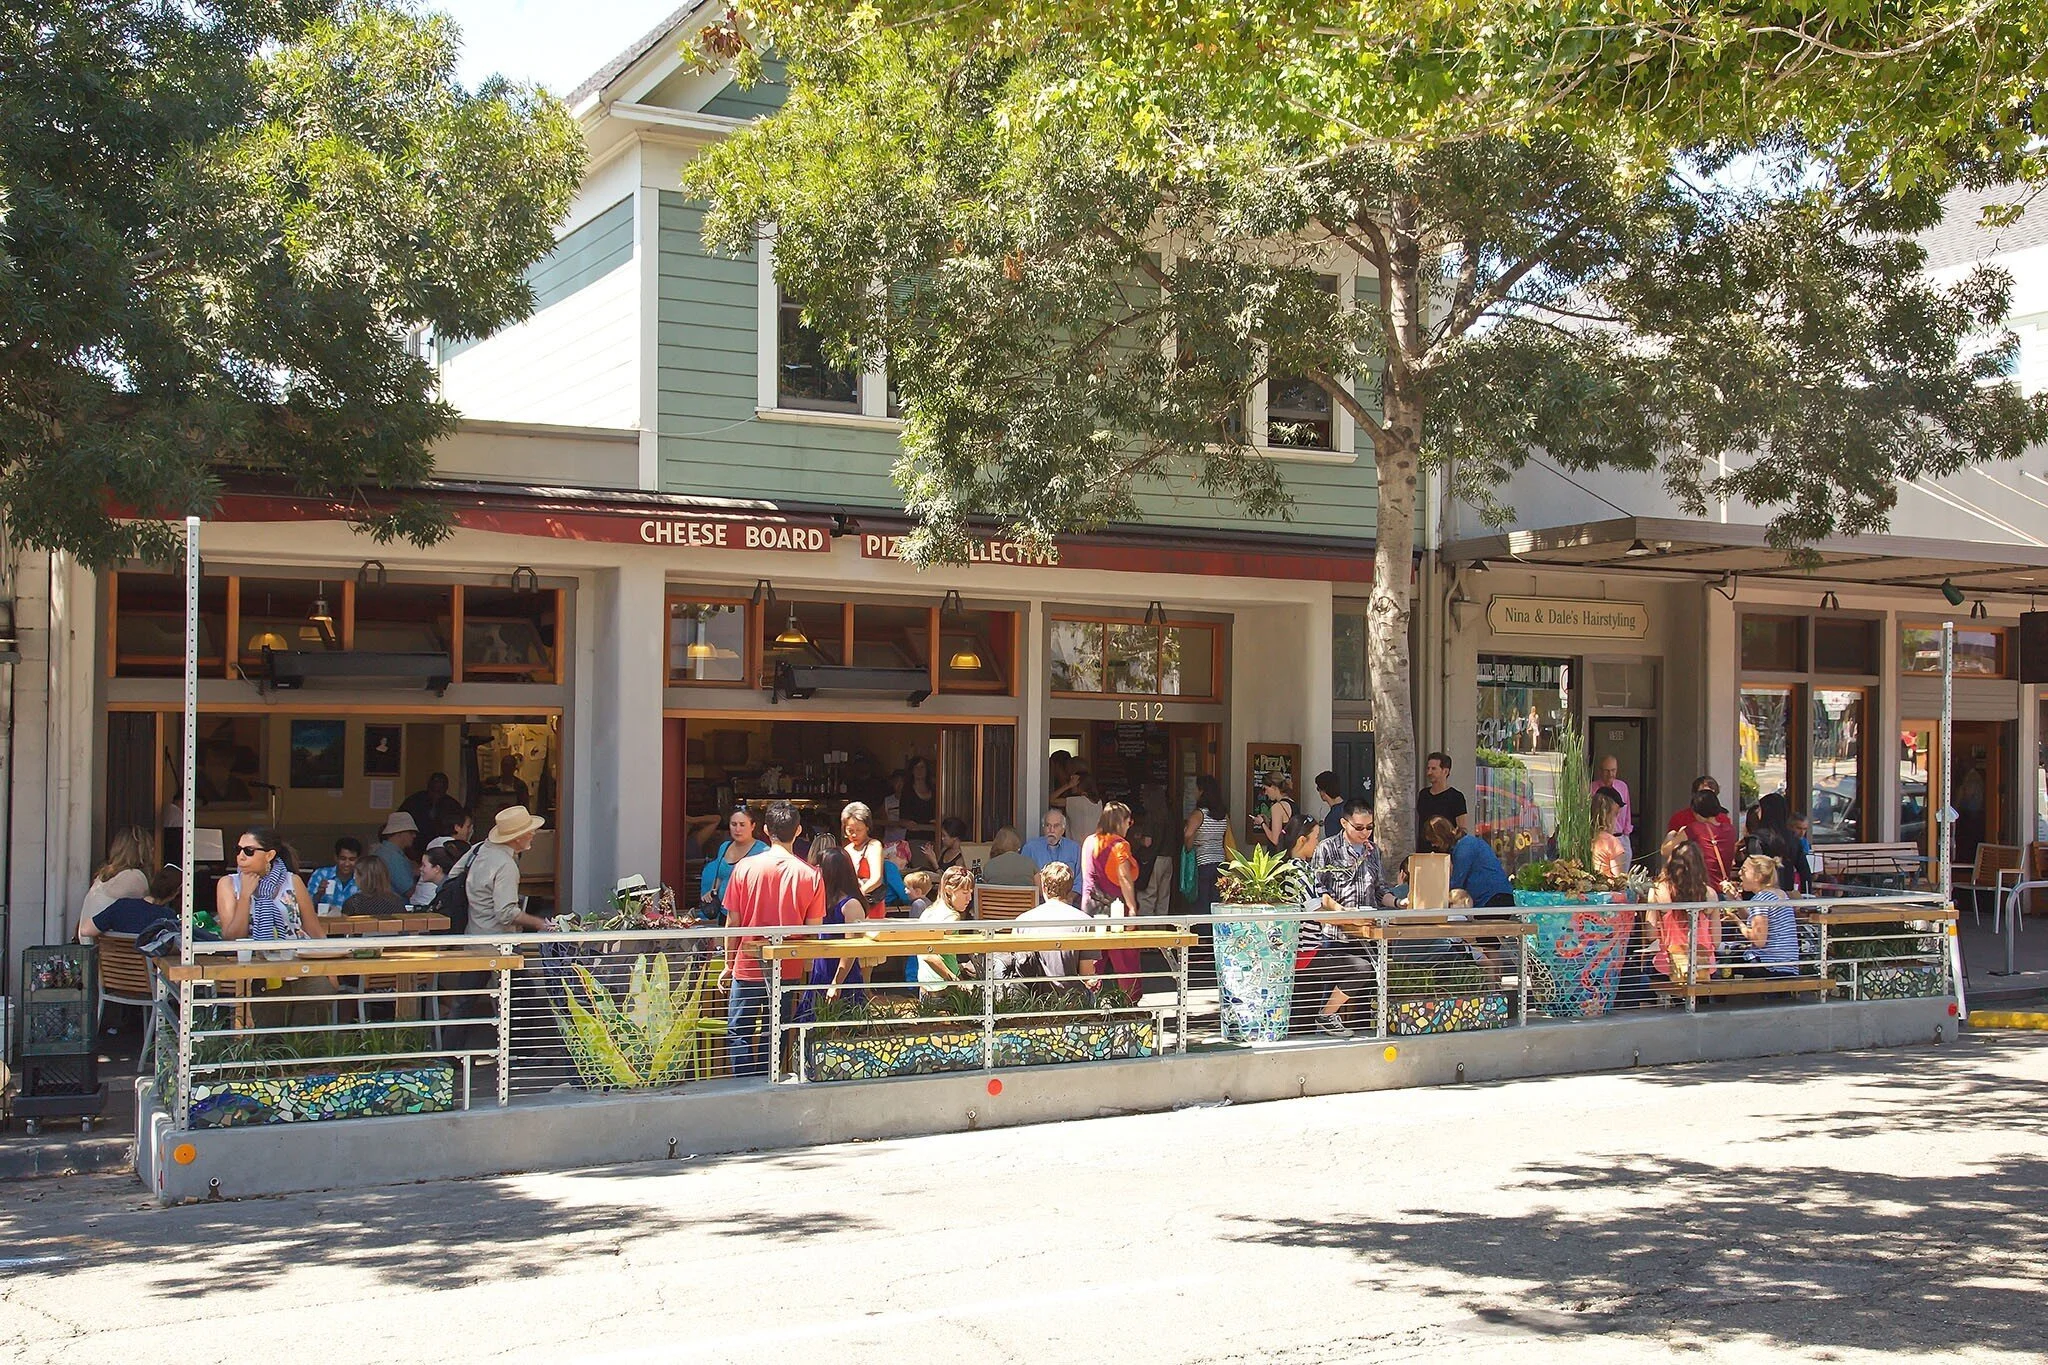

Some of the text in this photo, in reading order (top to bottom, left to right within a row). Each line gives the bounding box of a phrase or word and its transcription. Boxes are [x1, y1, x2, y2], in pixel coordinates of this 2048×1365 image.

[640, 521, 823, 550] CHEESE BOARD
[1505, 607, 1636, 630] Nina & Dale's Hairstyling
[1119, 702, 1164, 720] 1512
